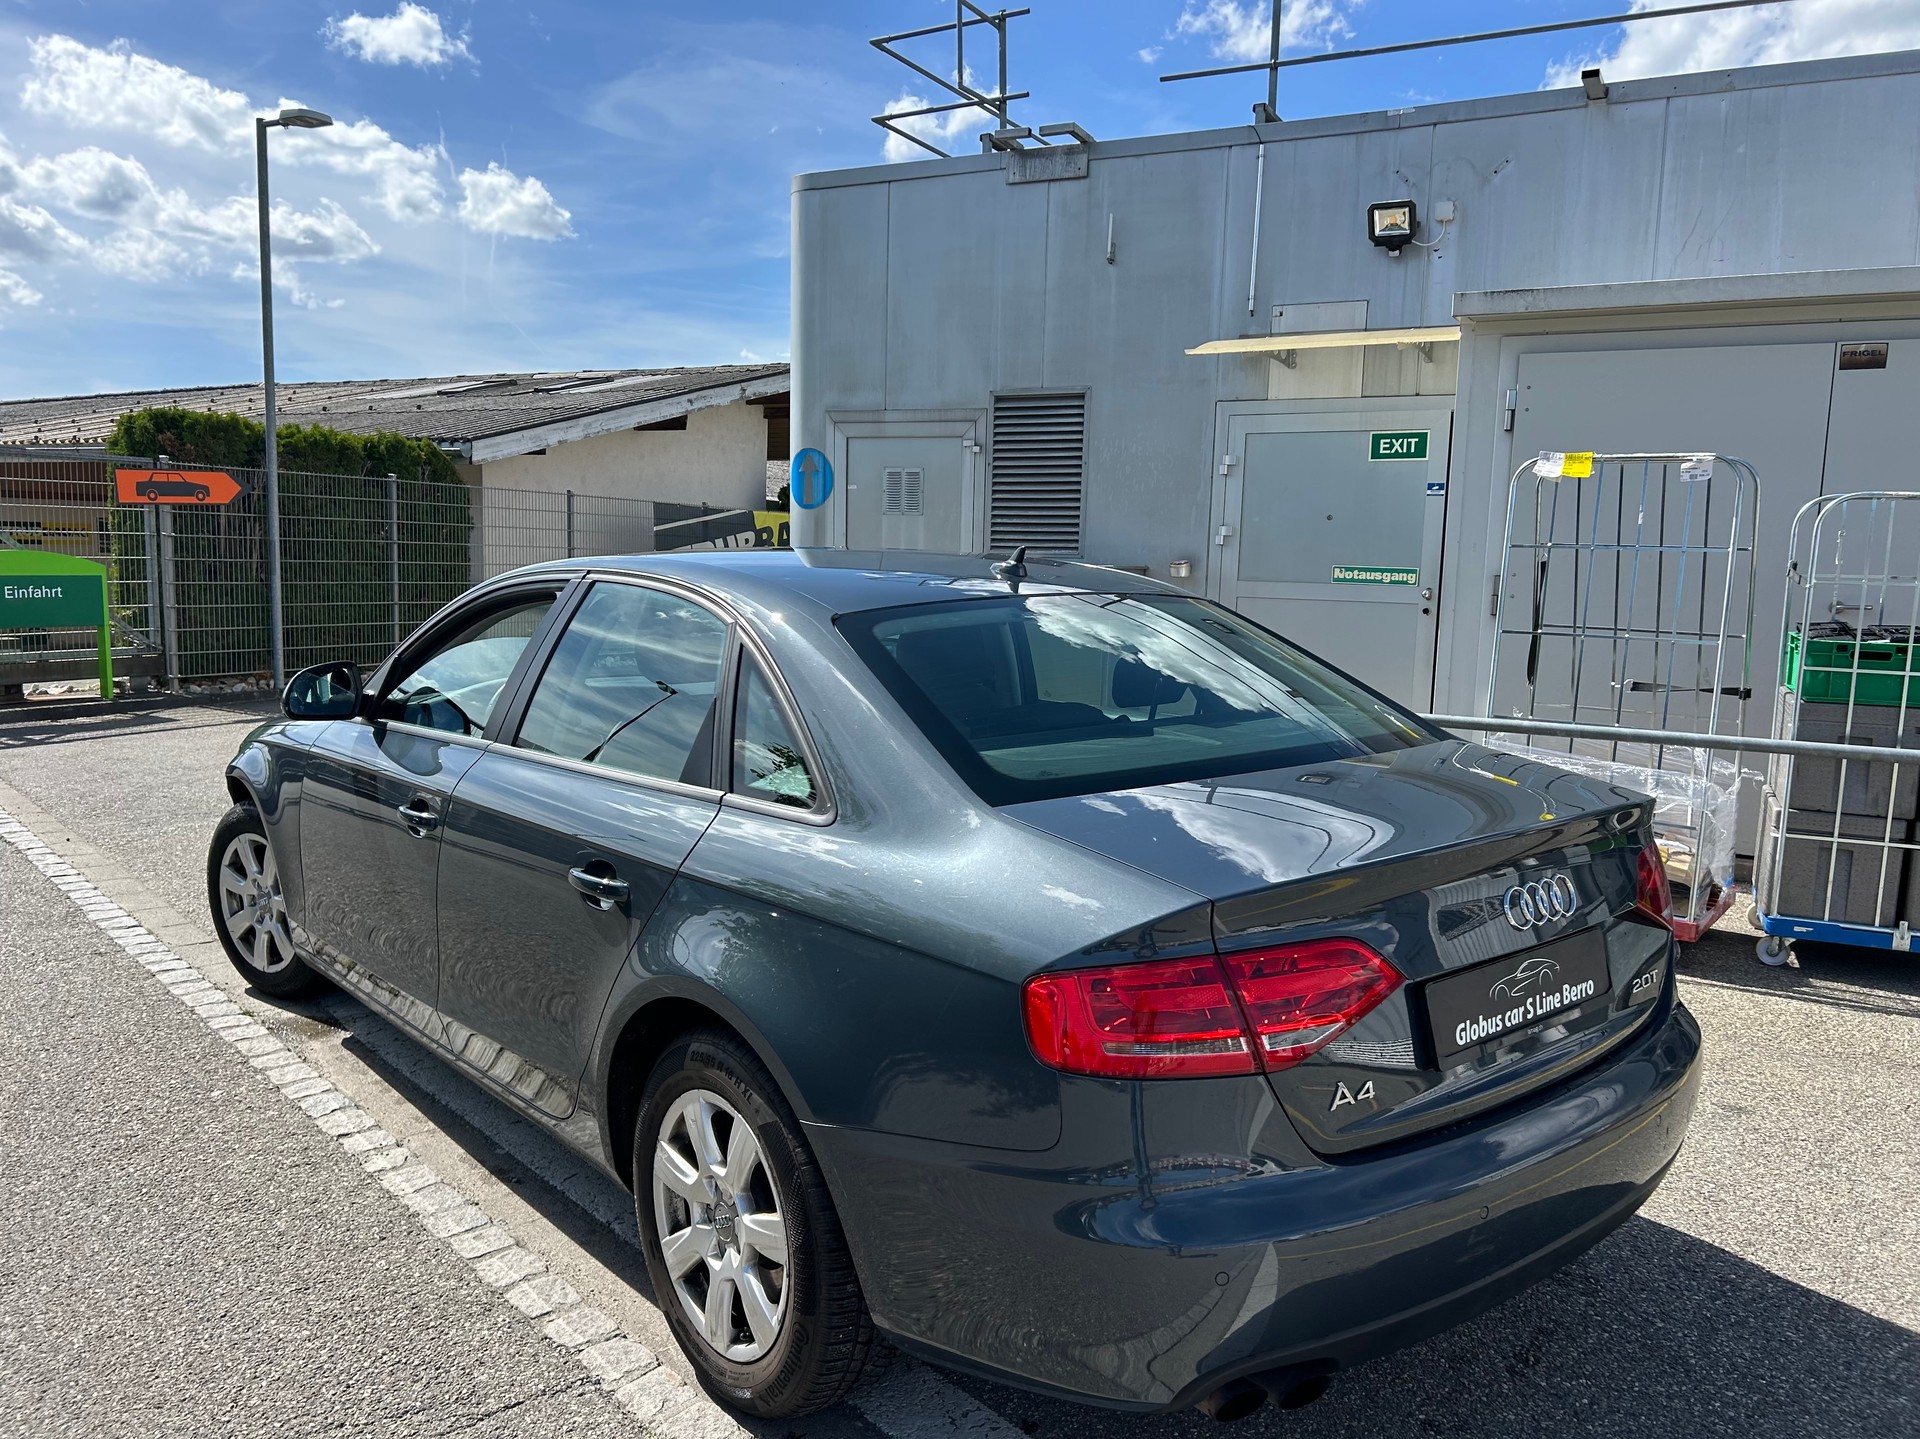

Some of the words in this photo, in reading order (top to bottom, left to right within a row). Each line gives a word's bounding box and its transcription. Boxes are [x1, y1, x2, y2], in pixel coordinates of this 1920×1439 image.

[1842, 349, 1886, 357] FRIGEL
[1379, 438, 1419, 454] EXIT
[1333, 567, 1417, 584] Notausgang
[4, 585, 63, 599] Einfahrt
[1455, 1014, 1503, 1046] Globus
[1504, 1007, 1525, 1028] car
[1526, 996, 1534, 1020] S
[1536, 991, 1562, 1015] Line
[1562, 979, 1595, 1005] Berro
[690, 1050, 717, 1069] 225/55
[1329, 1080, 1376, 1112] A4
